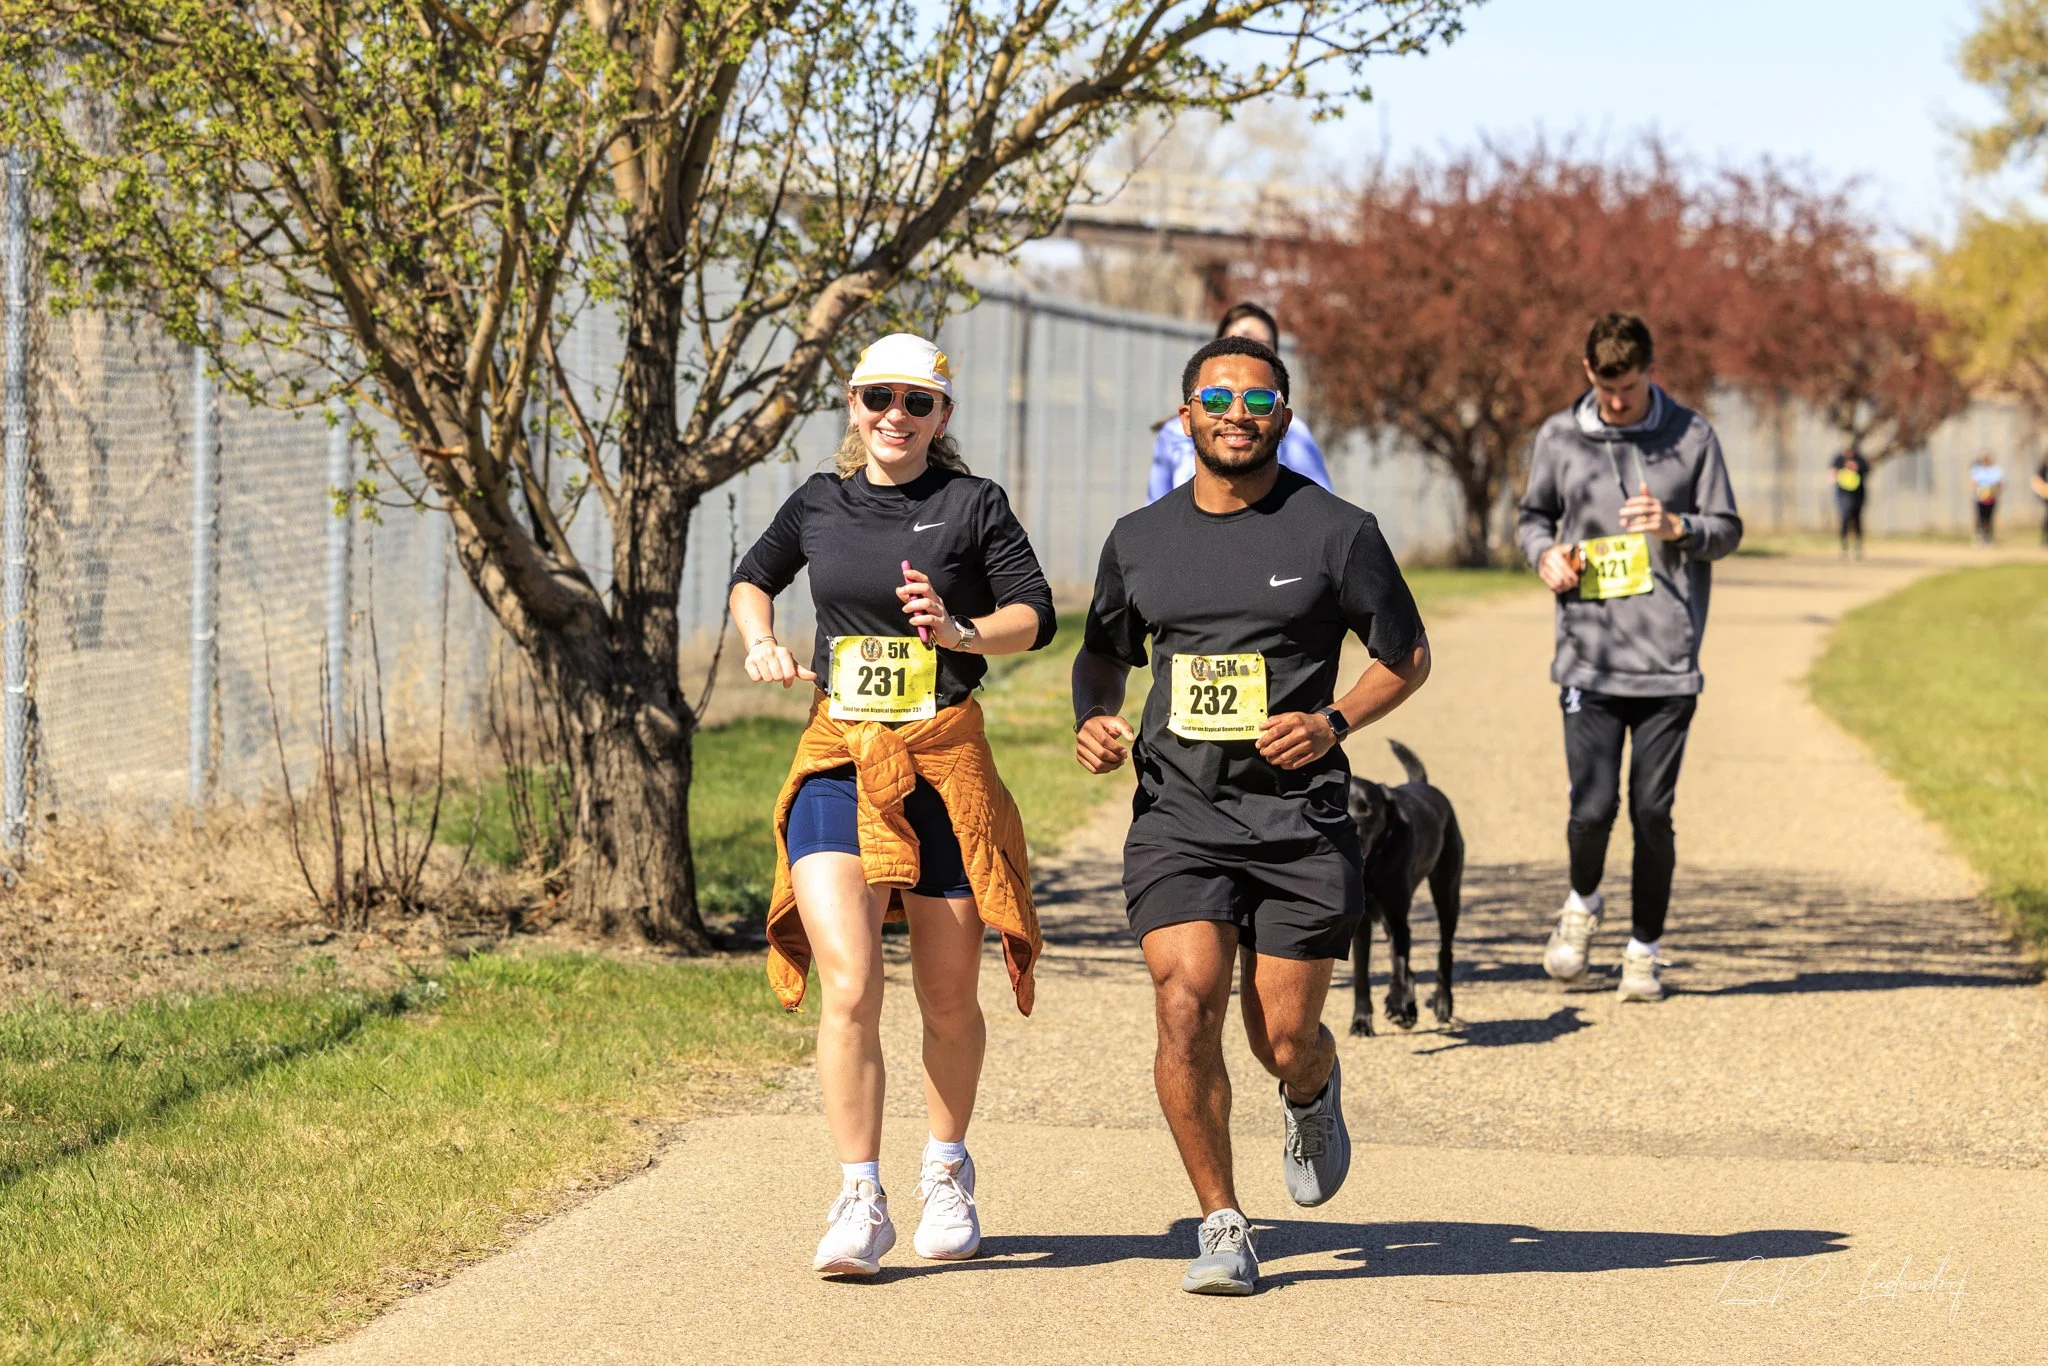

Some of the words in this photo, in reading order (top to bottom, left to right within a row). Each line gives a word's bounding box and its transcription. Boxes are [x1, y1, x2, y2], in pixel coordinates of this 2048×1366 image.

[888, 642, 909, 659] 5K
[1215, 660, 1238, 677] 5K
[857, 665, 905, 696] 231
[1190, 685, 1237, 715] 232
